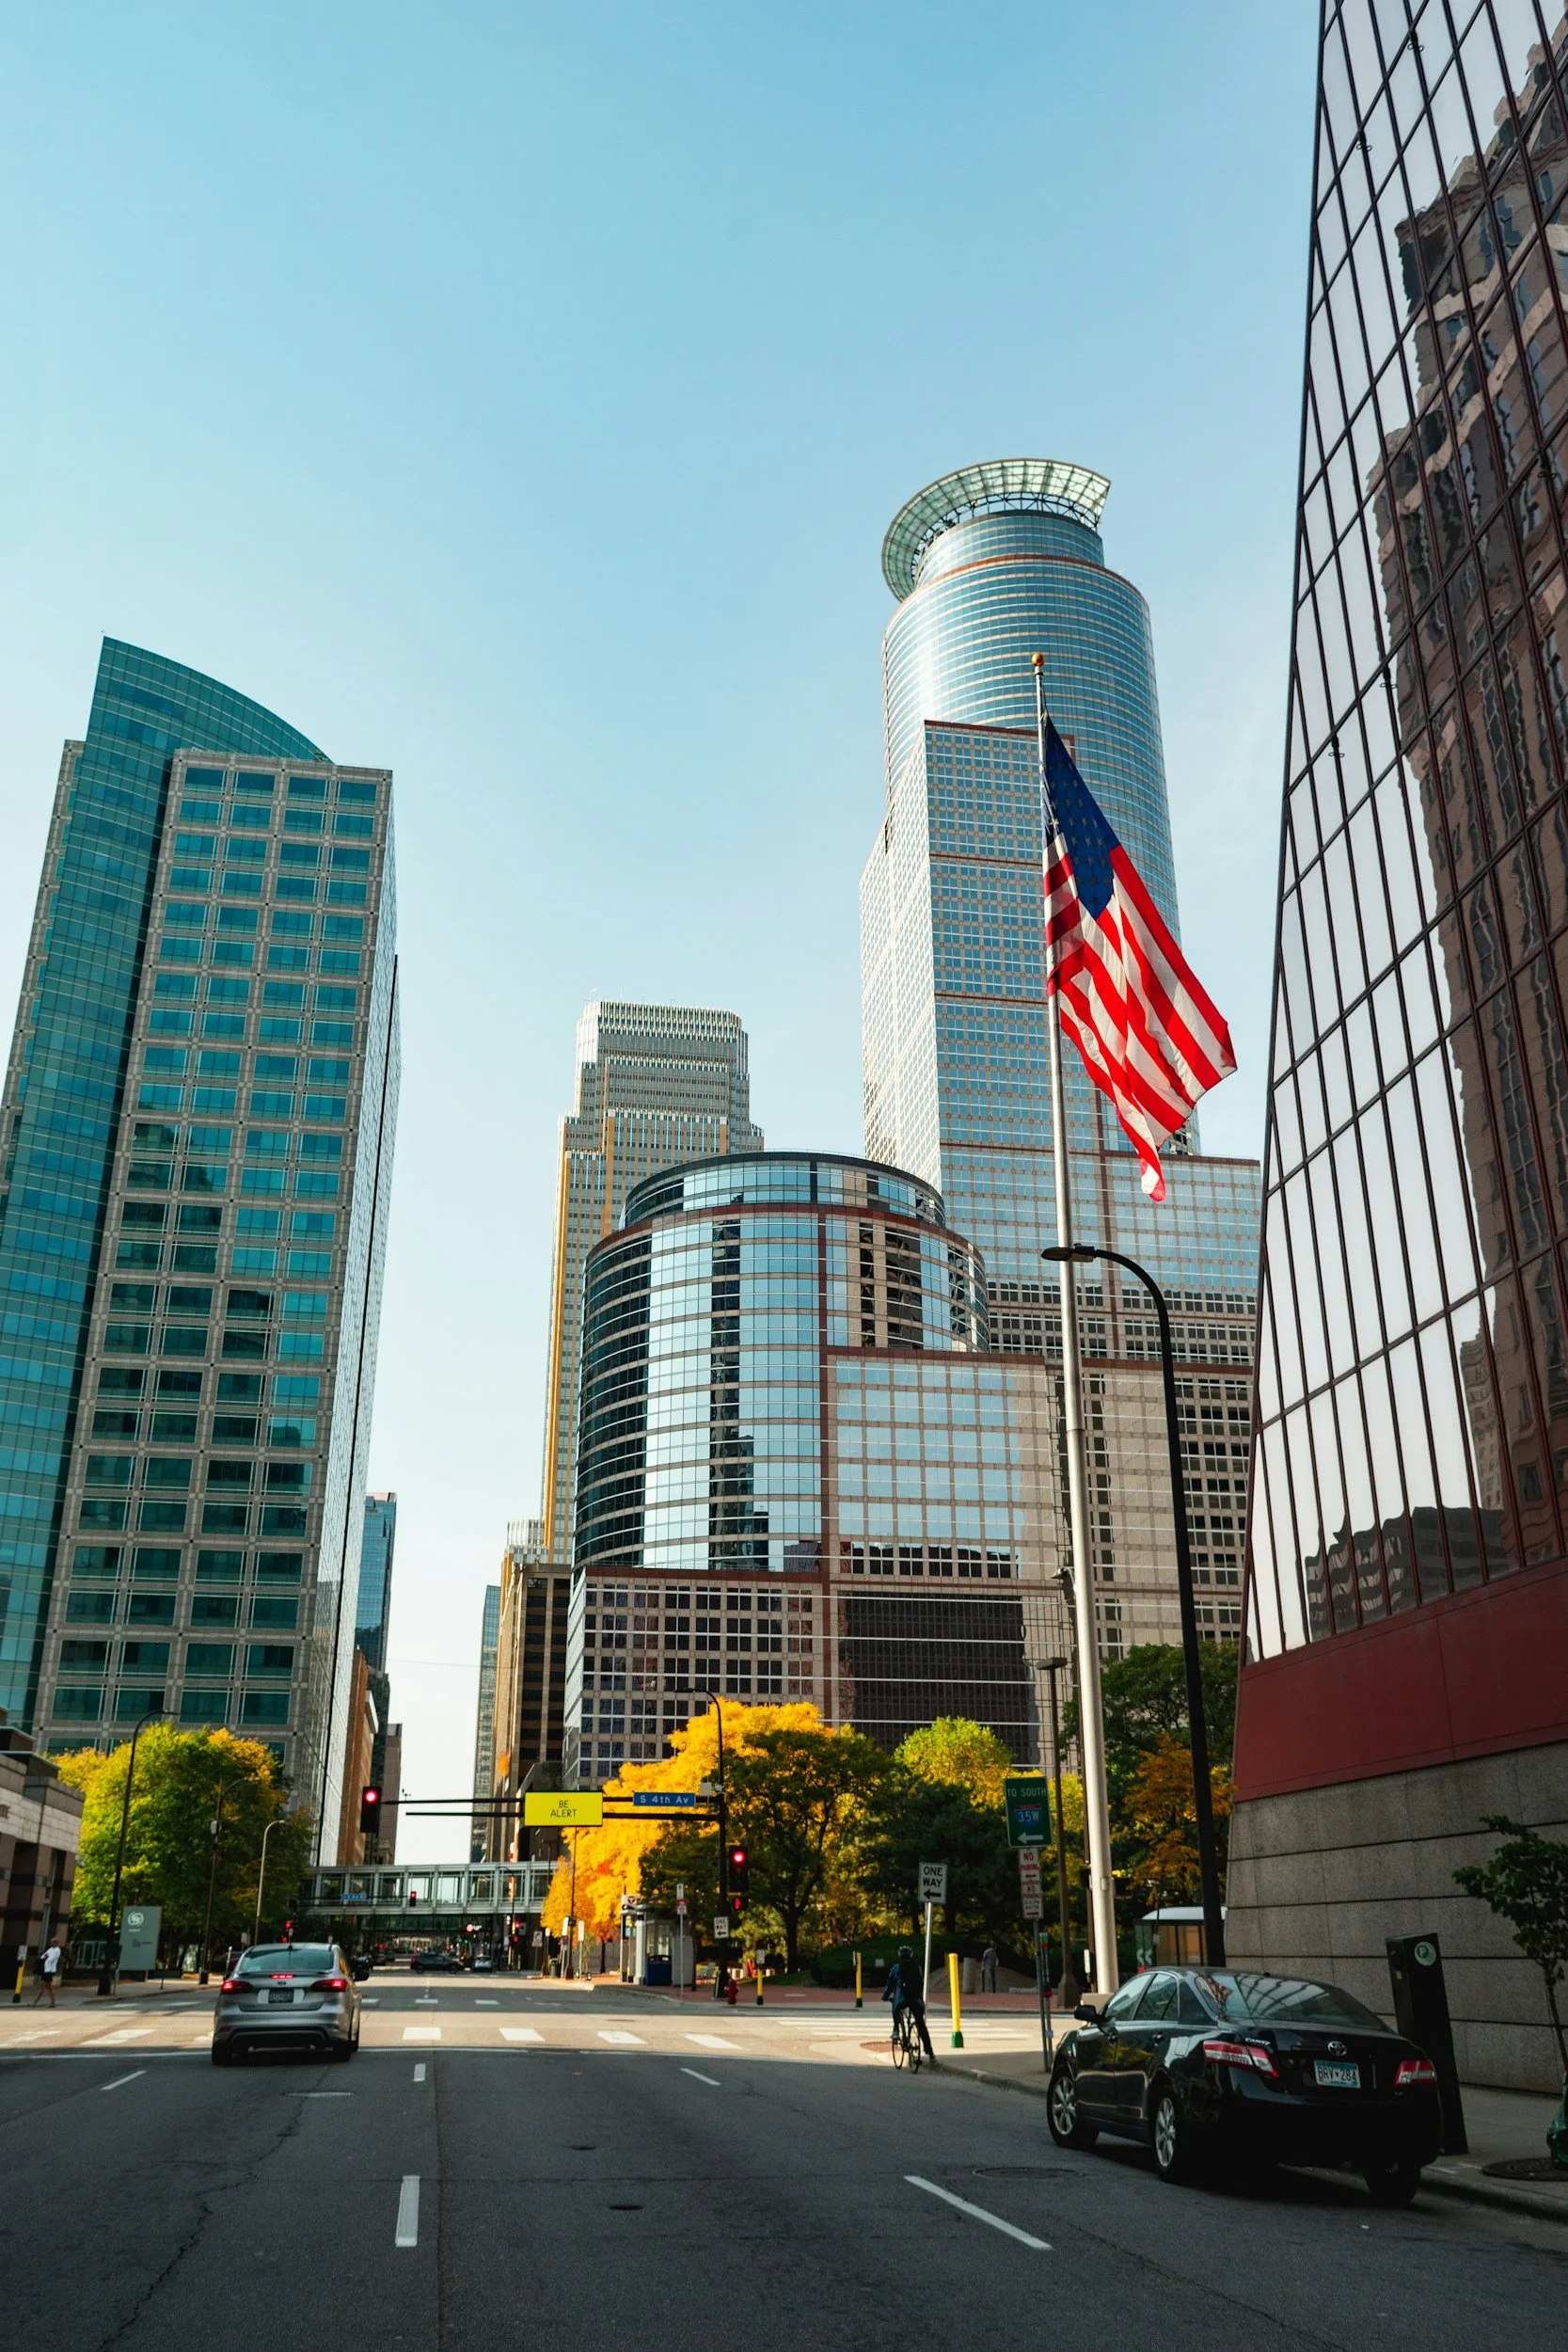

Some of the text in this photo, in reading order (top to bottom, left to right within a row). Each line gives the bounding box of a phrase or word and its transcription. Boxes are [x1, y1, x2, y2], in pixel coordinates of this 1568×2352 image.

[1006, 1787, 1046, 1798] TO SOUTH
[558, 1800, 569, 1808] BE
[640, 1795, 689, 1804] S 4th Av
[550, 1809, 577, 1818] ALERT
[1018, 1810, 1039, 1823] 35W
[1023, 1851, 1034, 1861] NO
[924, 1866, 943, 1877] ONE
[923, 1877, 942, 1887] WAY
[1026, 1884, 1036, 1893] NO
